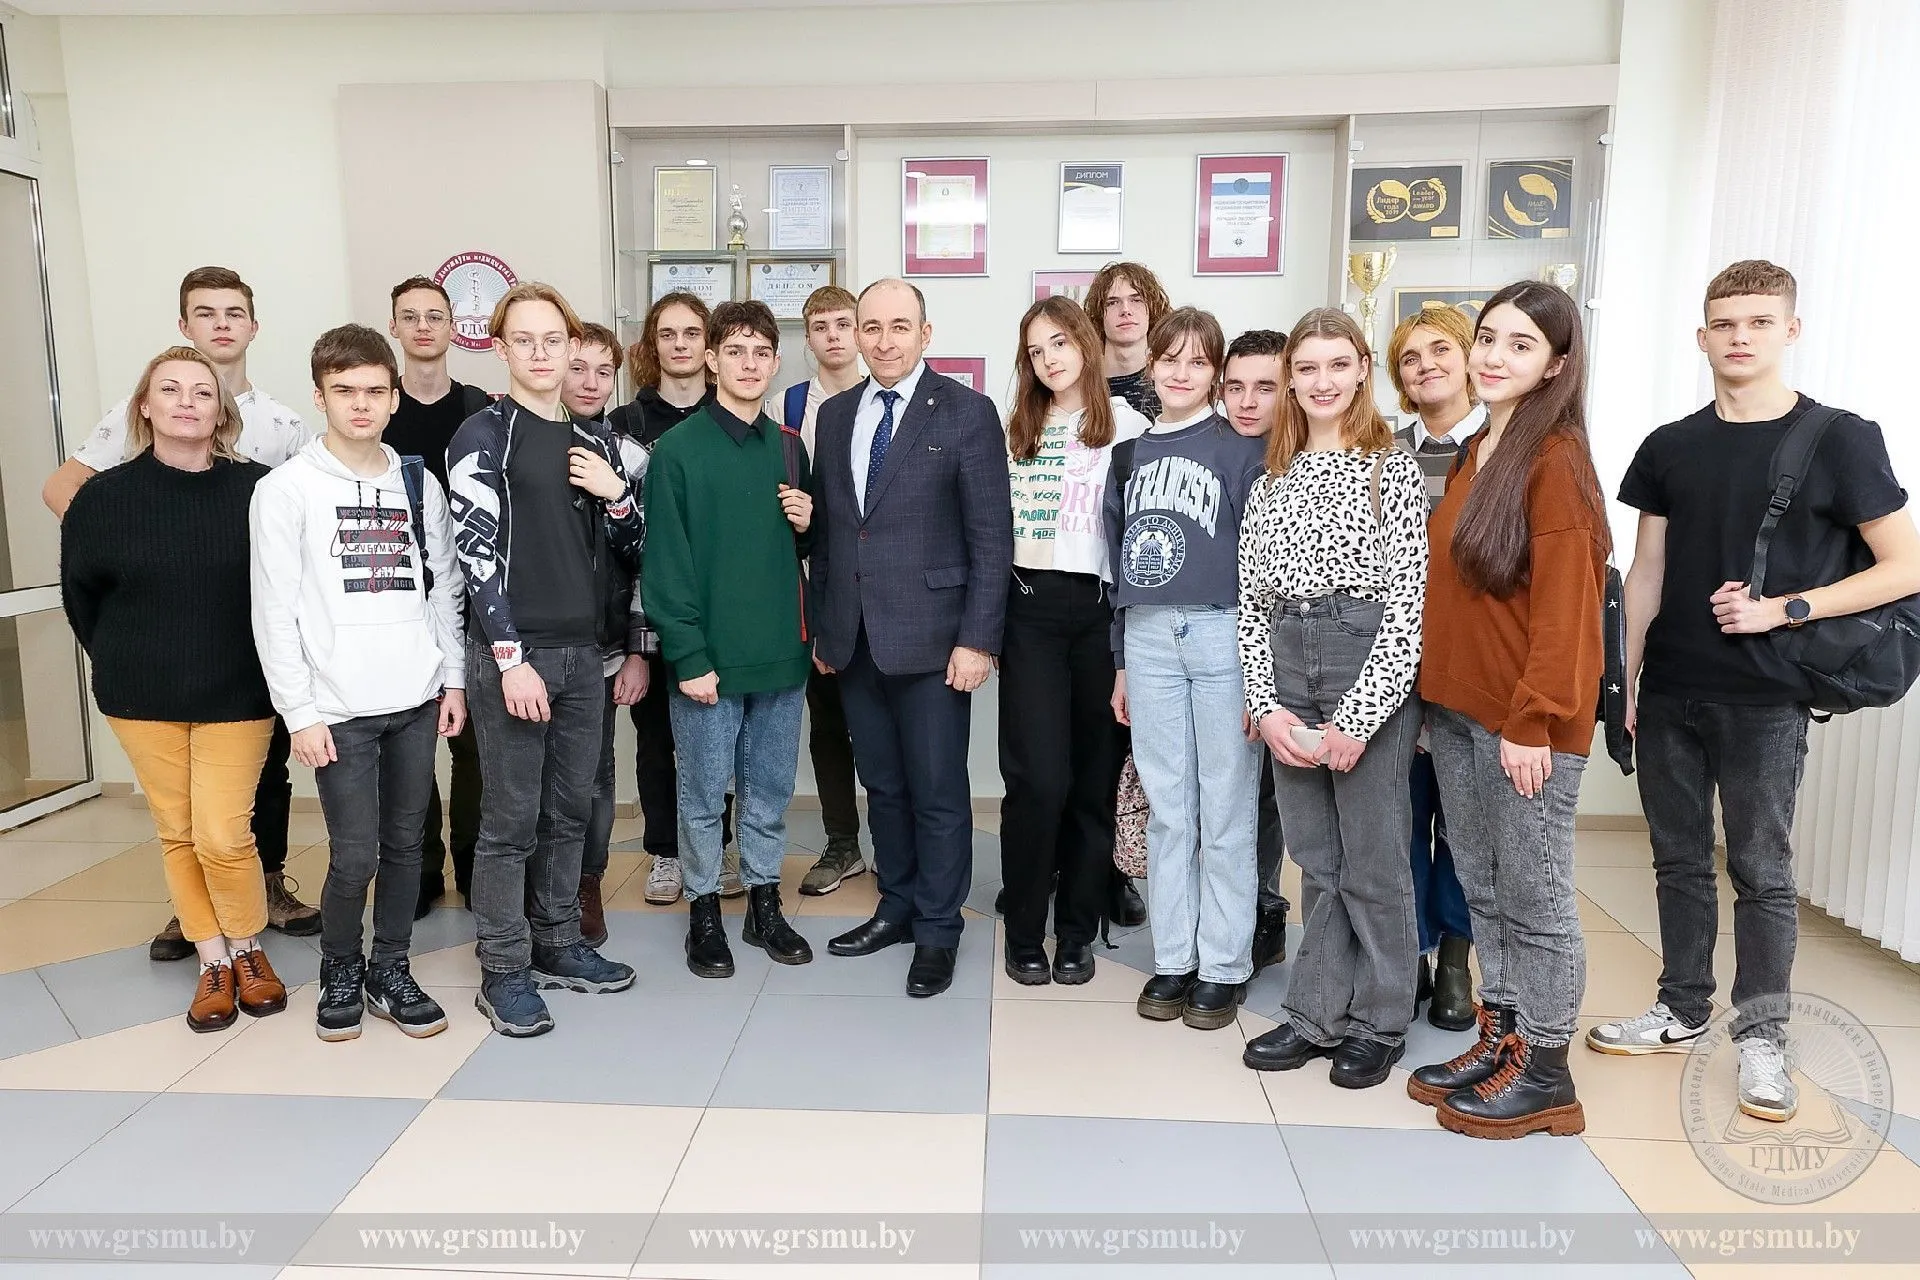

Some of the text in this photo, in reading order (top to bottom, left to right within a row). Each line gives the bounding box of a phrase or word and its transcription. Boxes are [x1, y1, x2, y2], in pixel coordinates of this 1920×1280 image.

[1075, 171, 1108, 179] ДИПЛОМ
[461, 323, 489, 336] ГДМ
[369, 580, 413, 589] STRNGTH
